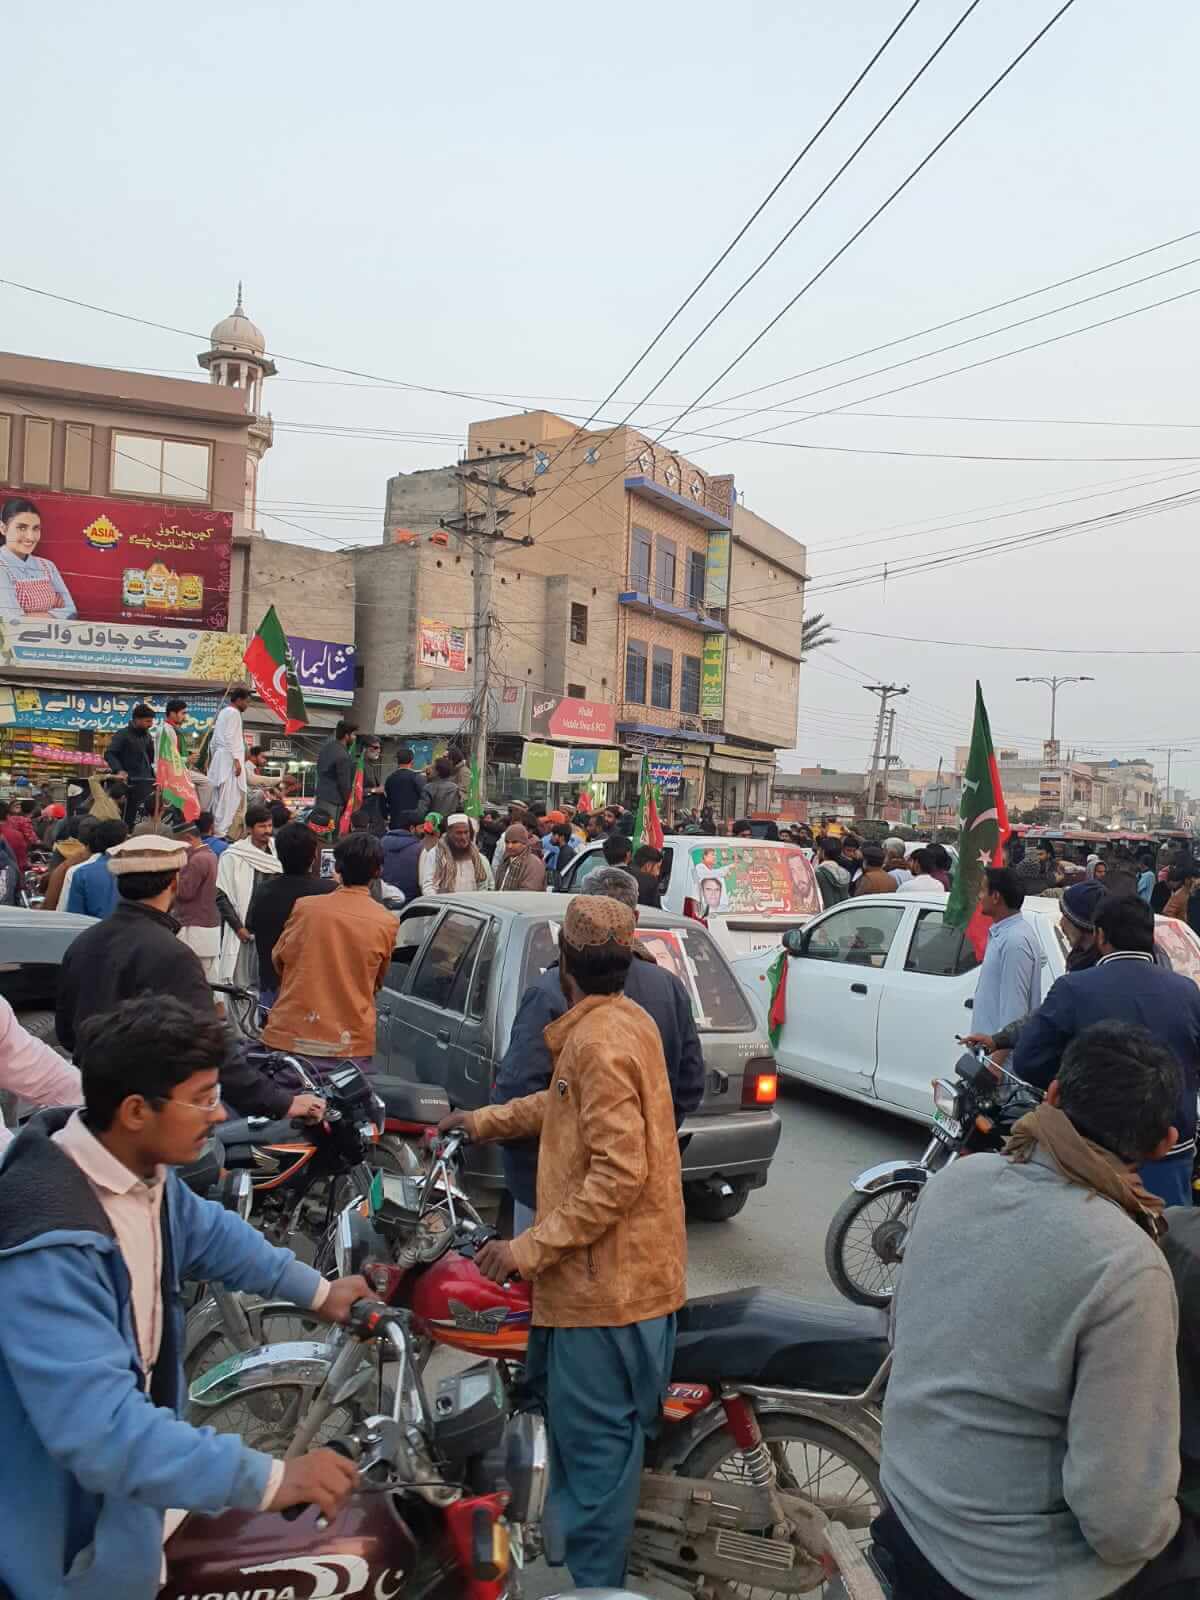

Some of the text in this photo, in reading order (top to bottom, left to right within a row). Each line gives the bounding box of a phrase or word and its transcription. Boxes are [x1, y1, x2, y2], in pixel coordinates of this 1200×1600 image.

[90, 527, 116, 539] ASIA
[192, 527, 215, 541] کچن
[17, 623, 188, 652] جنگو چاول والے
[45, 694, 86, 713] والے
[89, 695, 130, 717] چاول
